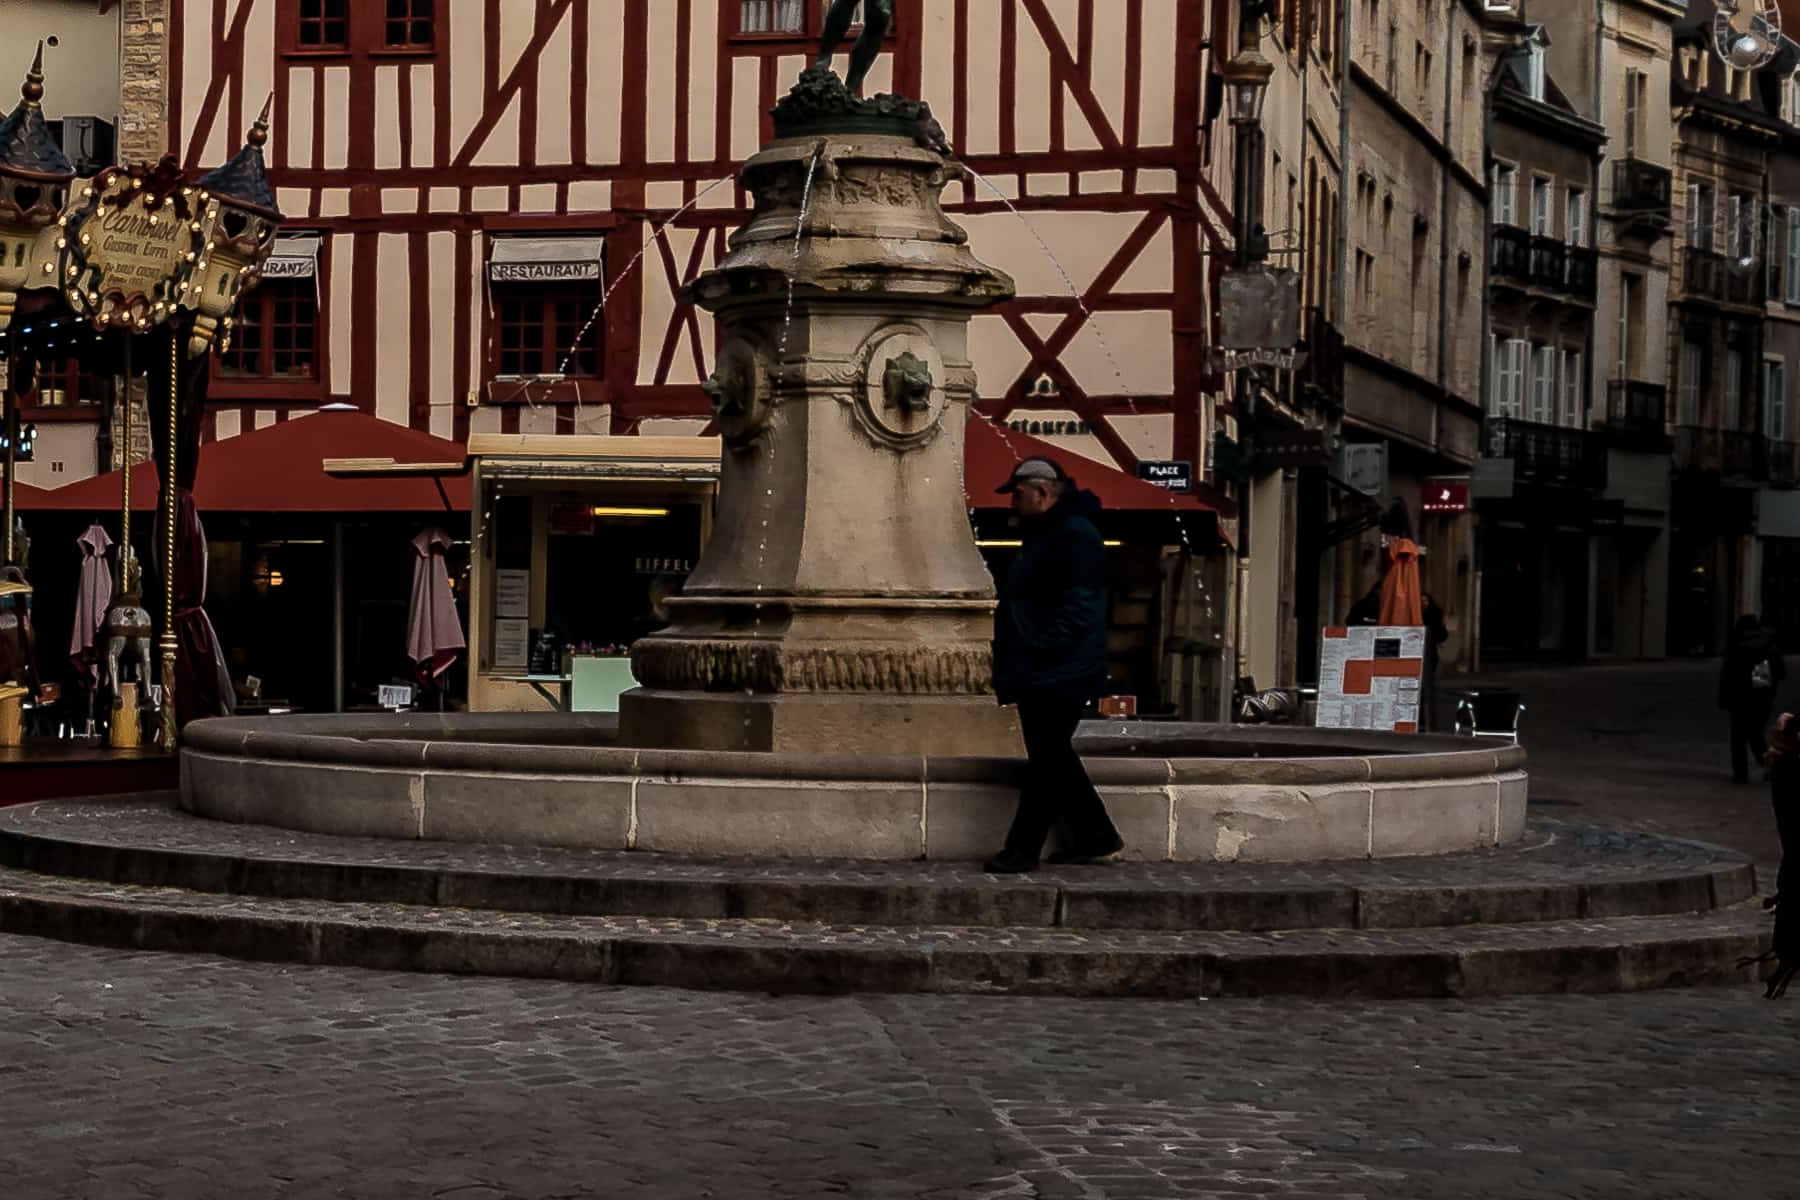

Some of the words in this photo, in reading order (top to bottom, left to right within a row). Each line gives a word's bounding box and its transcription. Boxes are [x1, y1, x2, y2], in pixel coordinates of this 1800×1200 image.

[103, 210, 182, 241] Carrousel
[500, 263, 591, 278] RESTAURANT
[1149, 465, 1180, 476] PLACE
